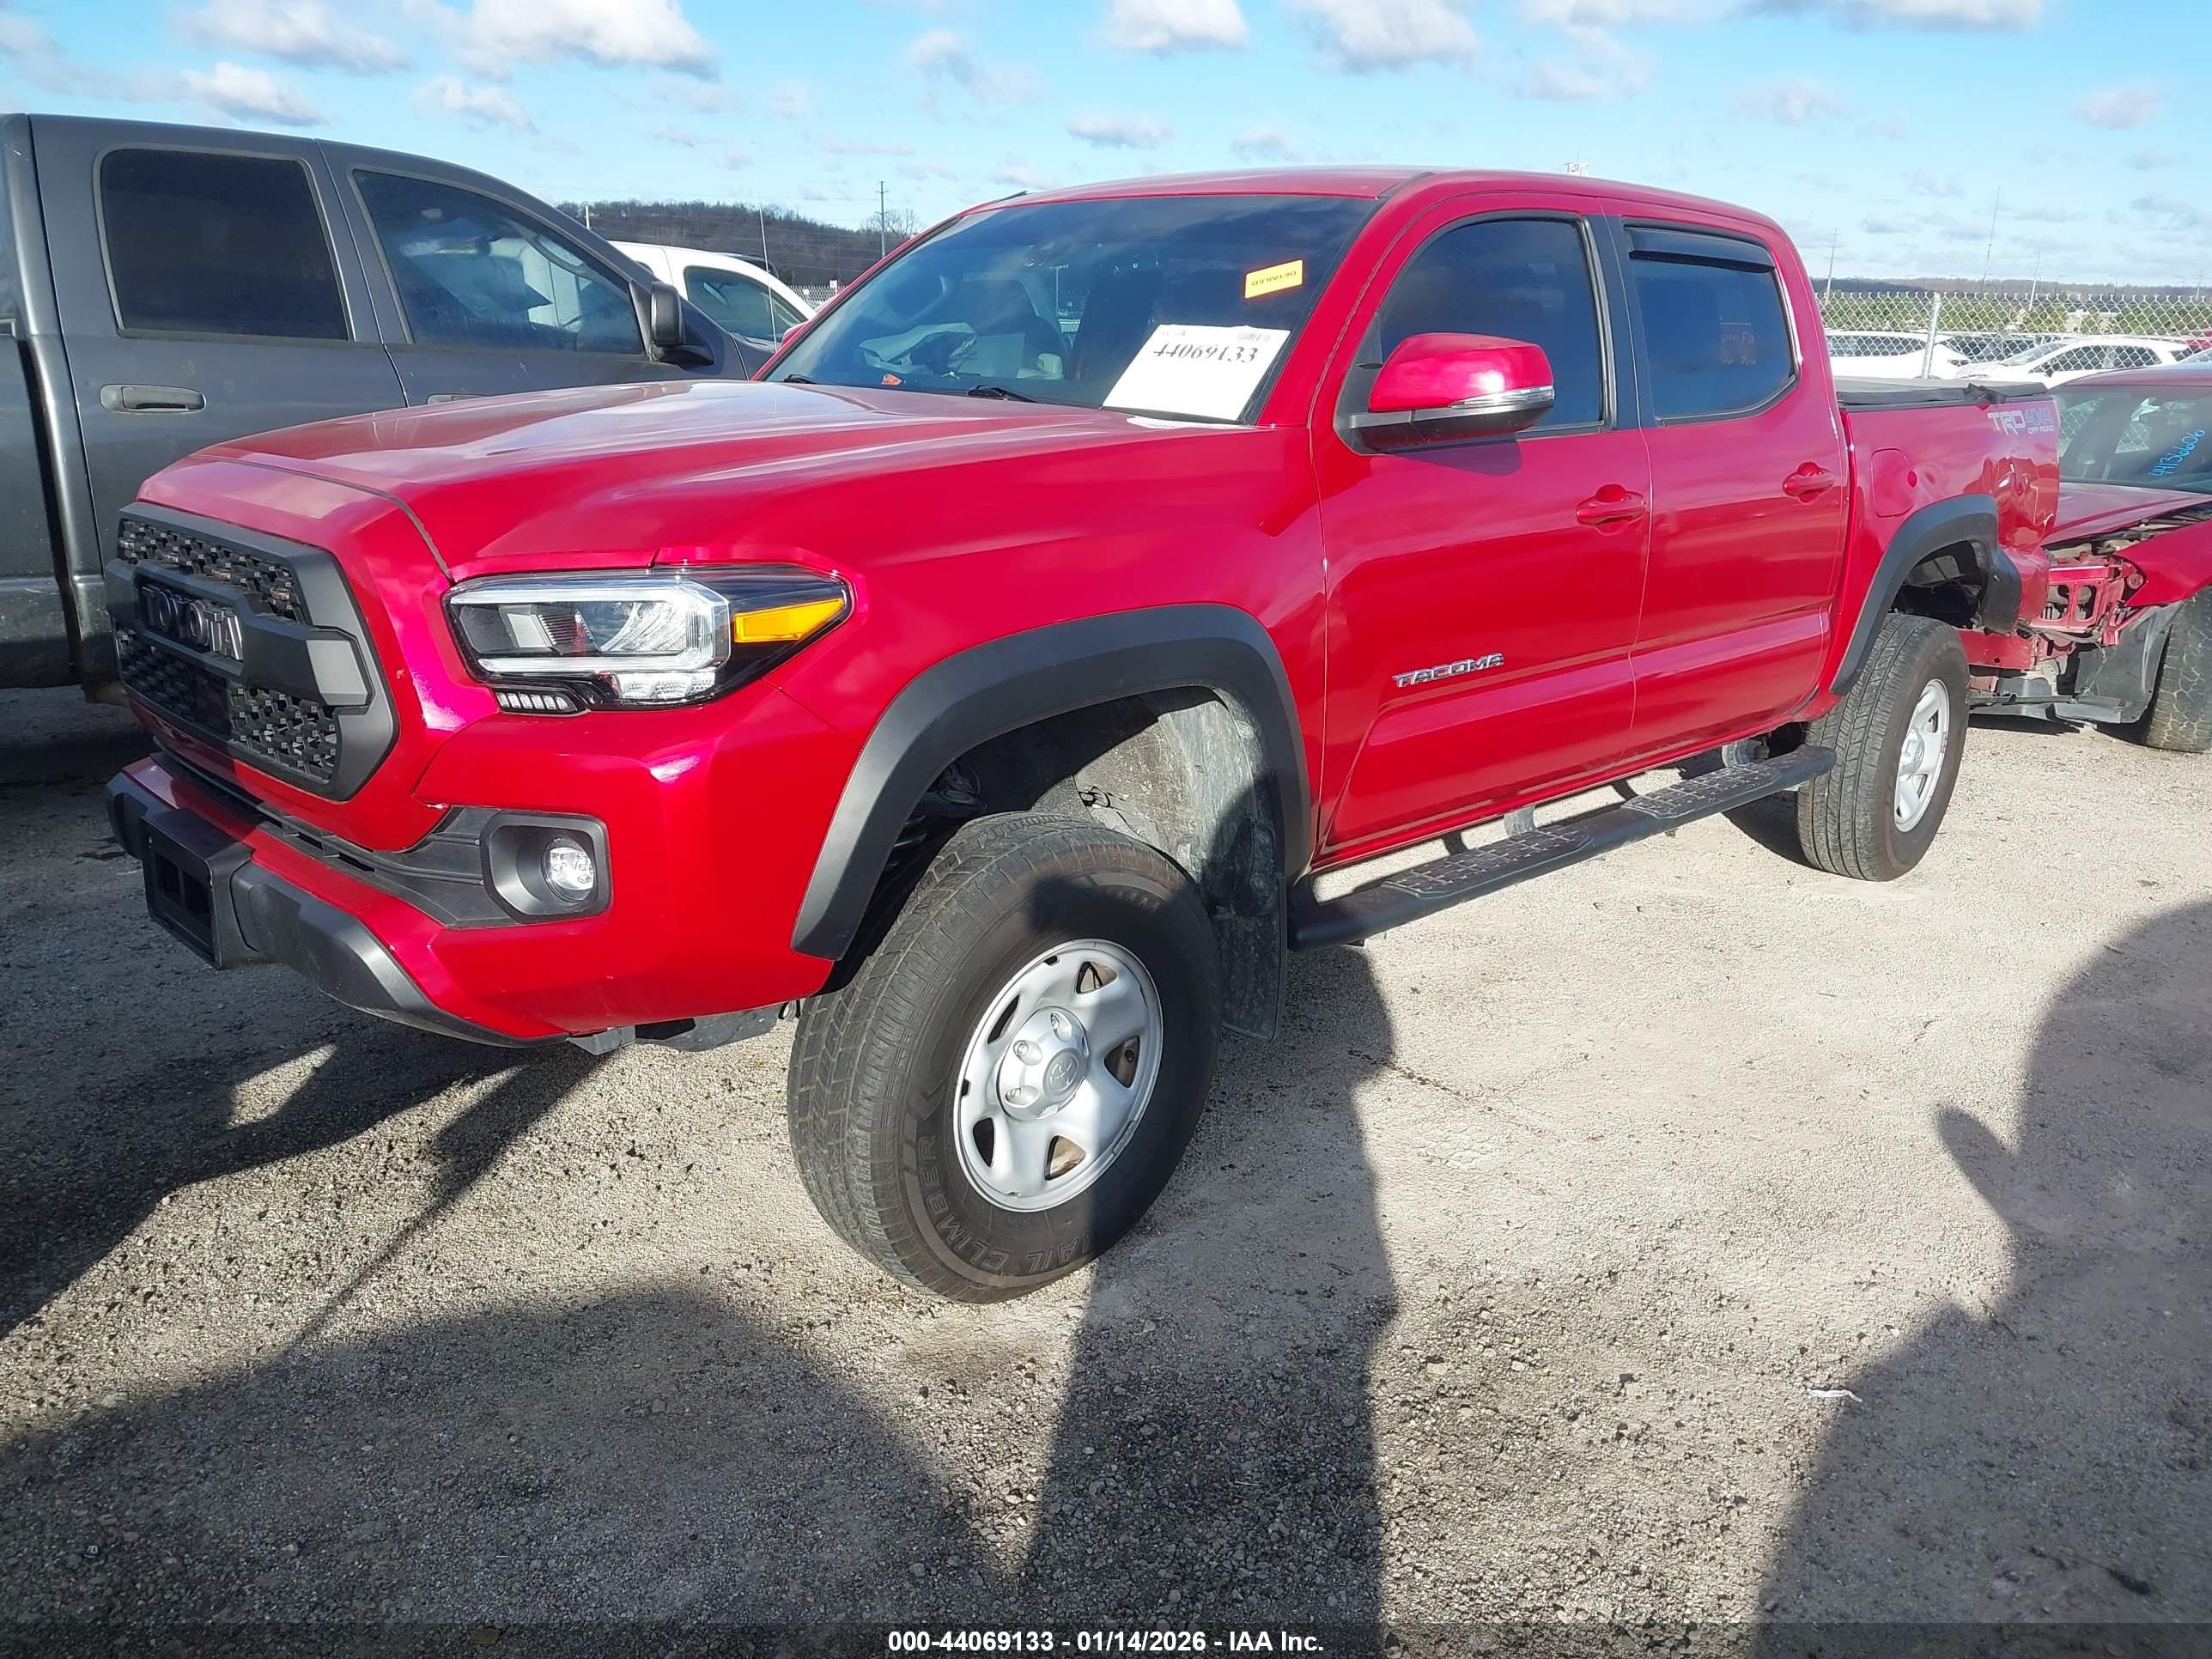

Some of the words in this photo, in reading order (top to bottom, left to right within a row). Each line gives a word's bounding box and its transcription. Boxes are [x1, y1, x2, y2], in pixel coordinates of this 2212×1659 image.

[1153, 343, 1260, 363] 44069133
[1986, 410, 2027, 436] TRD
[2027, 426, 2039, 434] OFF
[2148, 429, 2206, 477] 44136606
[141, 584, 245, 661] TOYOTA
[1390, 652, 1504, 688] TACOMA
[917, 1133, 1012, 1272] CLIMBER
